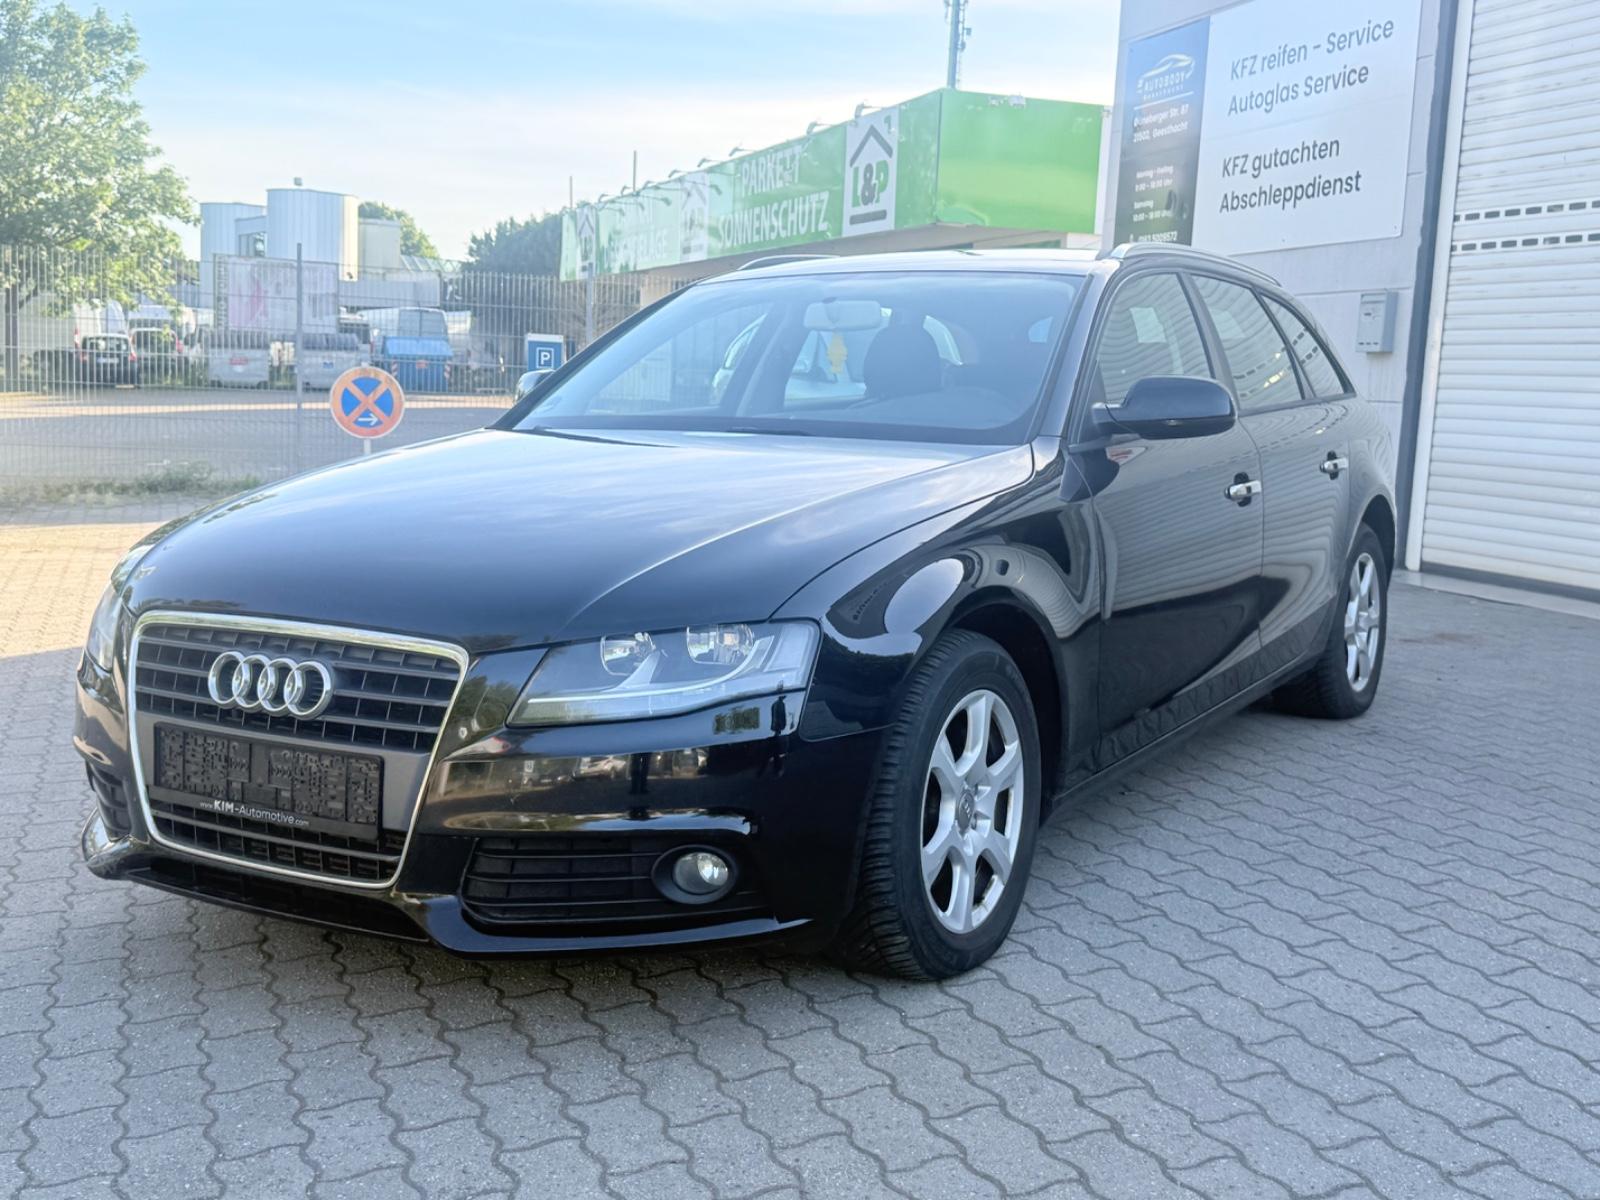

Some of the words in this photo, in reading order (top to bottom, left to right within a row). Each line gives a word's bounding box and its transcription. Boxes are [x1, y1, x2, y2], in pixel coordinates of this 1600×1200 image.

[1231, 54, 1257, 81] KFZ
[1261, 44, 1307, 73] reifen
[1326, 19, 1394, 54] Service
[1228, 82, 1299, 117] Autoglas
[1303, 64, 1369, 97] Service
[1222, 153, 1249, 178] KFZ
[1252, 139, 1340, 179] gutachten
[852, 160, 889, 208] L&P
[1219, 170, 1361, 214] Abschleppdienst
[718, 190, 829, 248] SONNENSCHUTZ
[541, 352, 550, 365] P
